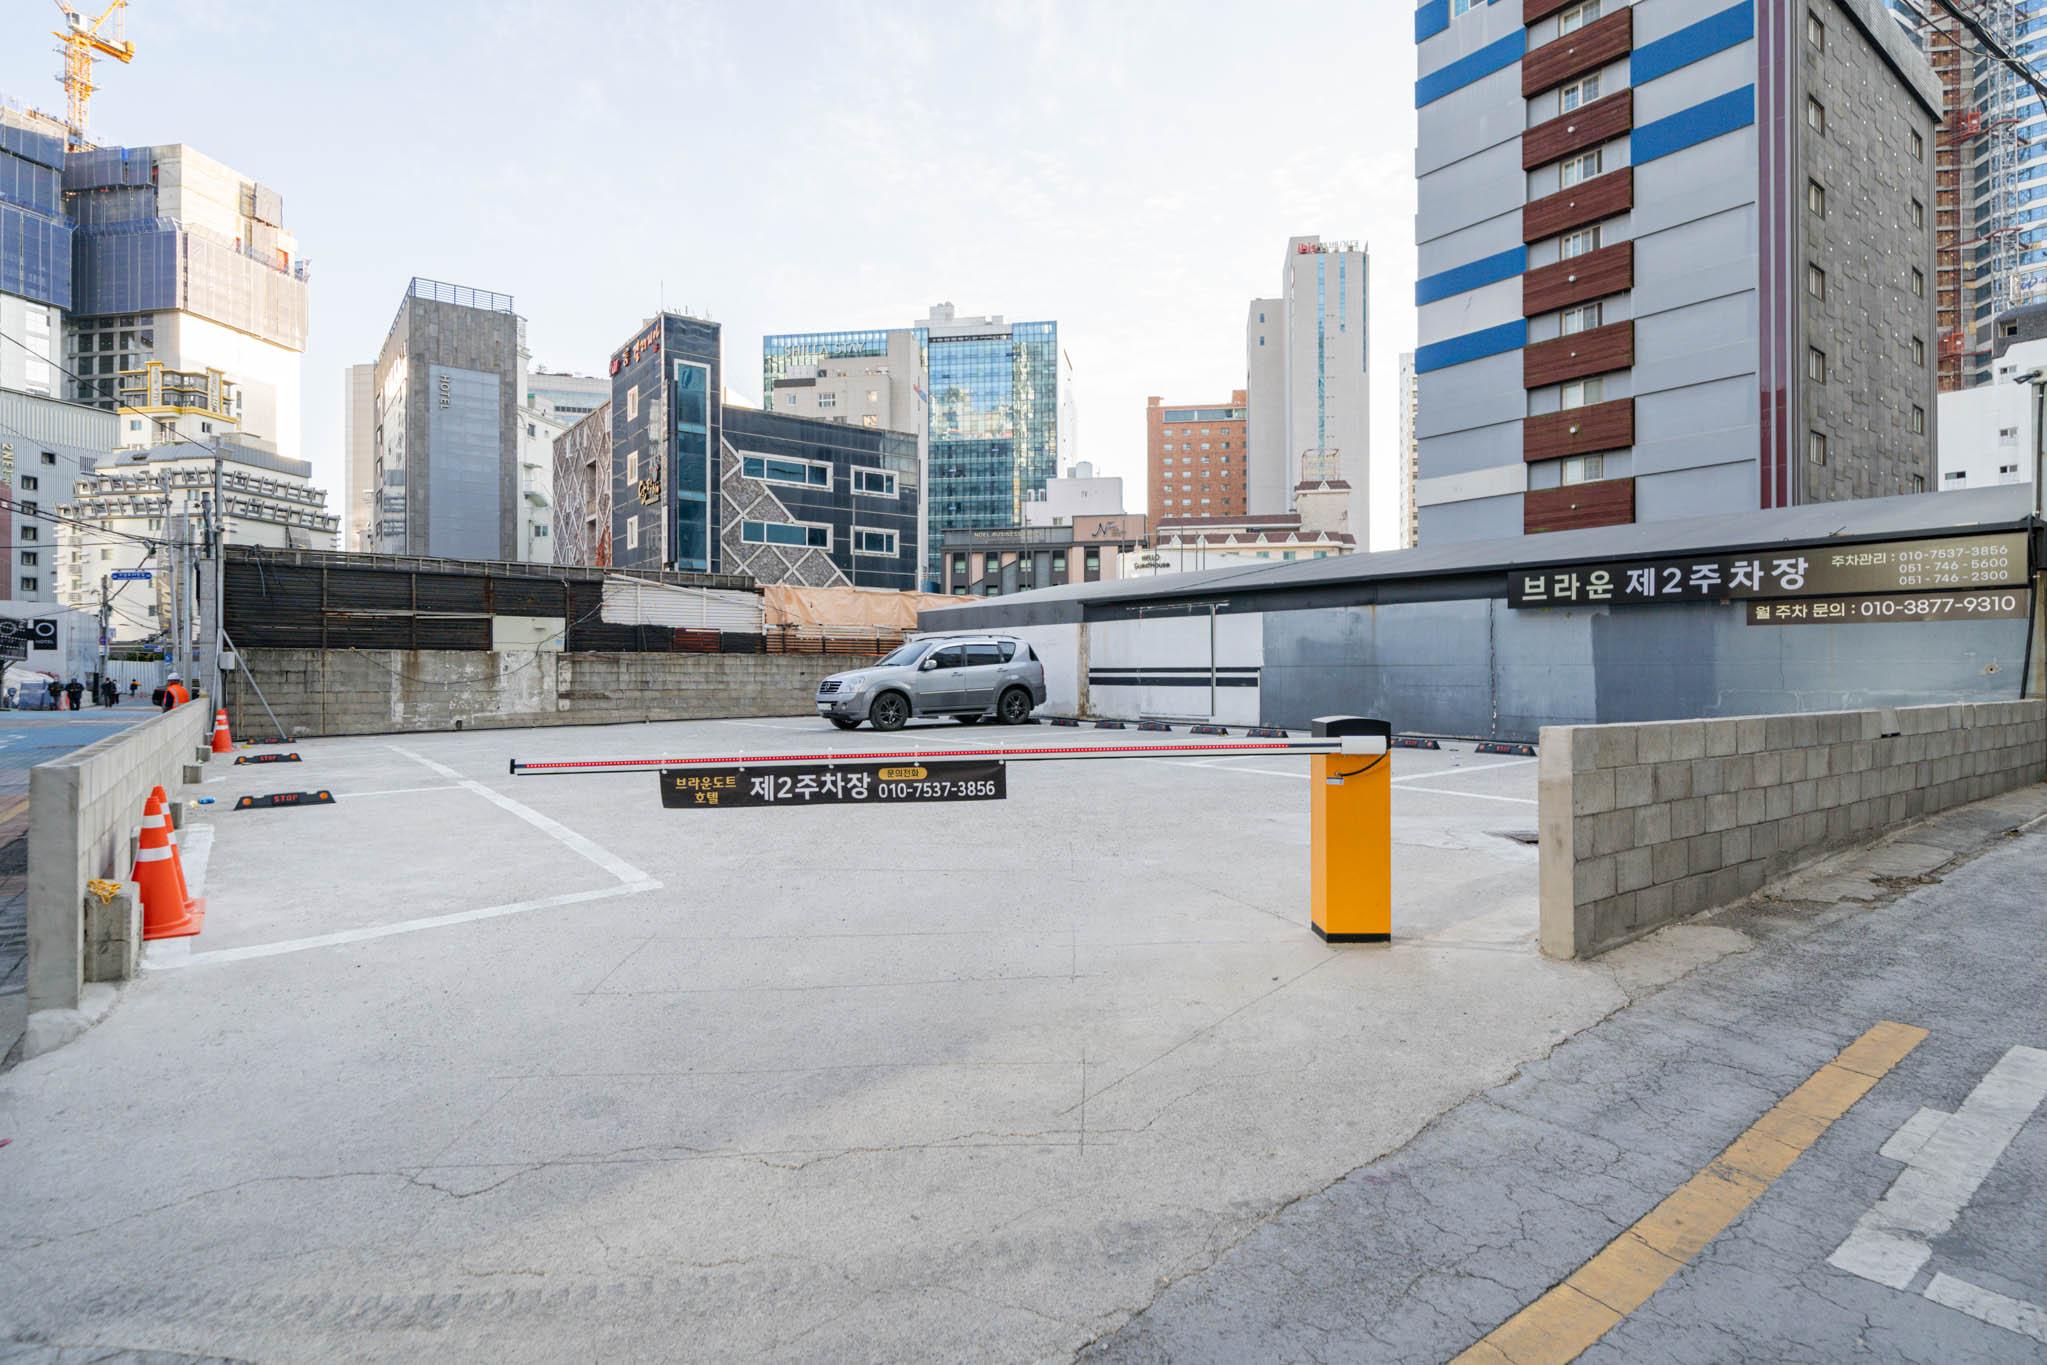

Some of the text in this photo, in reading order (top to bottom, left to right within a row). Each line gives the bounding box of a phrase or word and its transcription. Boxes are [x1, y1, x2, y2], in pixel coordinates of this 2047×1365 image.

[784, 342, 865, 356] SHILLA STAY
[440, 375, 451, 409] HOTEL
[1141, 554, 1161, 562] HELLO
[1831, 552, 1887, 567] 주차관리
[1899, 545, 2008, 562] 010-7537-3856
[1522, 556, 1808, 601] 브라운 제2주차장
[1755, 606, 1771, 620] 월
[1776, 604, 1808, 619] 주차
[1812, 602, 1846, 618] 문의
[1860, 595, 2016, 617] 010-3877-9310
[886, 768, 920, 778] 문의전화
[675, 775, 737, 790] 브라운도트
[750, 771, 871, 802] 제2주차장
[878, 780, 996, 799] 010-7537-3856
[273, 794, 299, 803] STOP
[695, 792, 719, 805] 호텔
